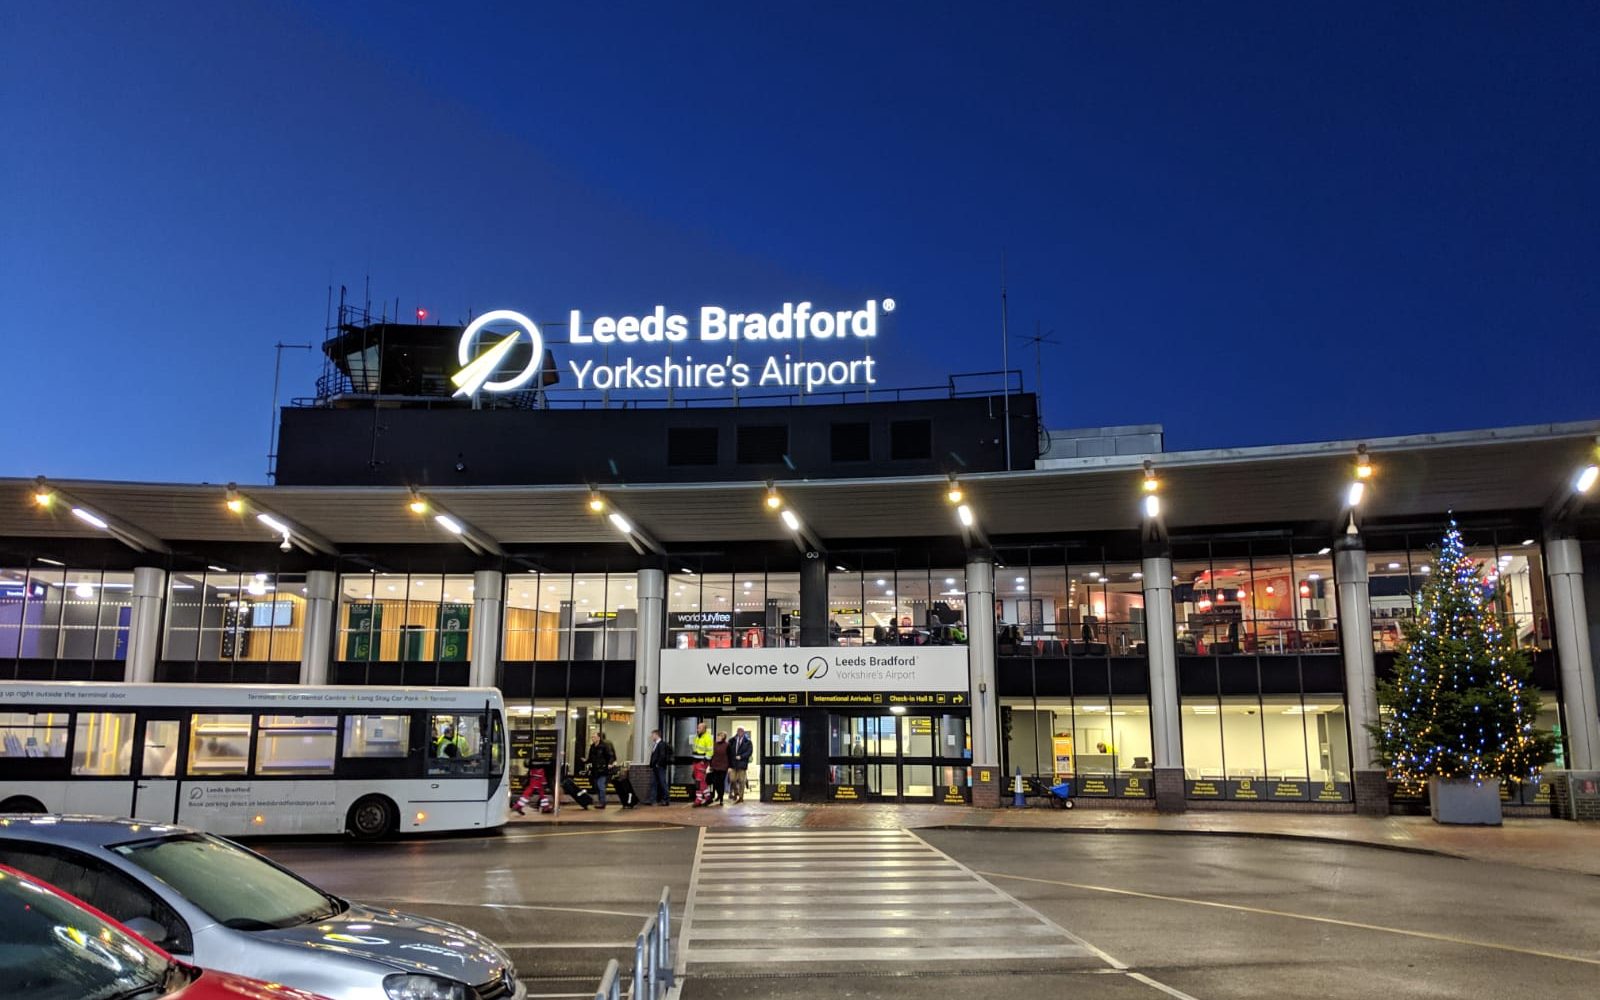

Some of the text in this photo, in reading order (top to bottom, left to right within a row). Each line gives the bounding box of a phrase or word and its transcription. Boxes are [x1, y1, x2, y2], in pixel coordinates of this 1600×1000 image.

[569, 305, 688, 344] Leeds
[569, 354, 877, 393] Yorkshire's Airport
[835, 655, 916, 667] Leeds Bradford
[706, 662, 800, 676] Welcome to
[836, 669, 916, 682] Yorkshire's Airport
[16, 690, 34, 699] right
[36, 690, 62, 699] outside
[78, 691, 108, 699] terminal
[679, 696, 704, 704] Check-in
[204, 800, 229, 808] parking
